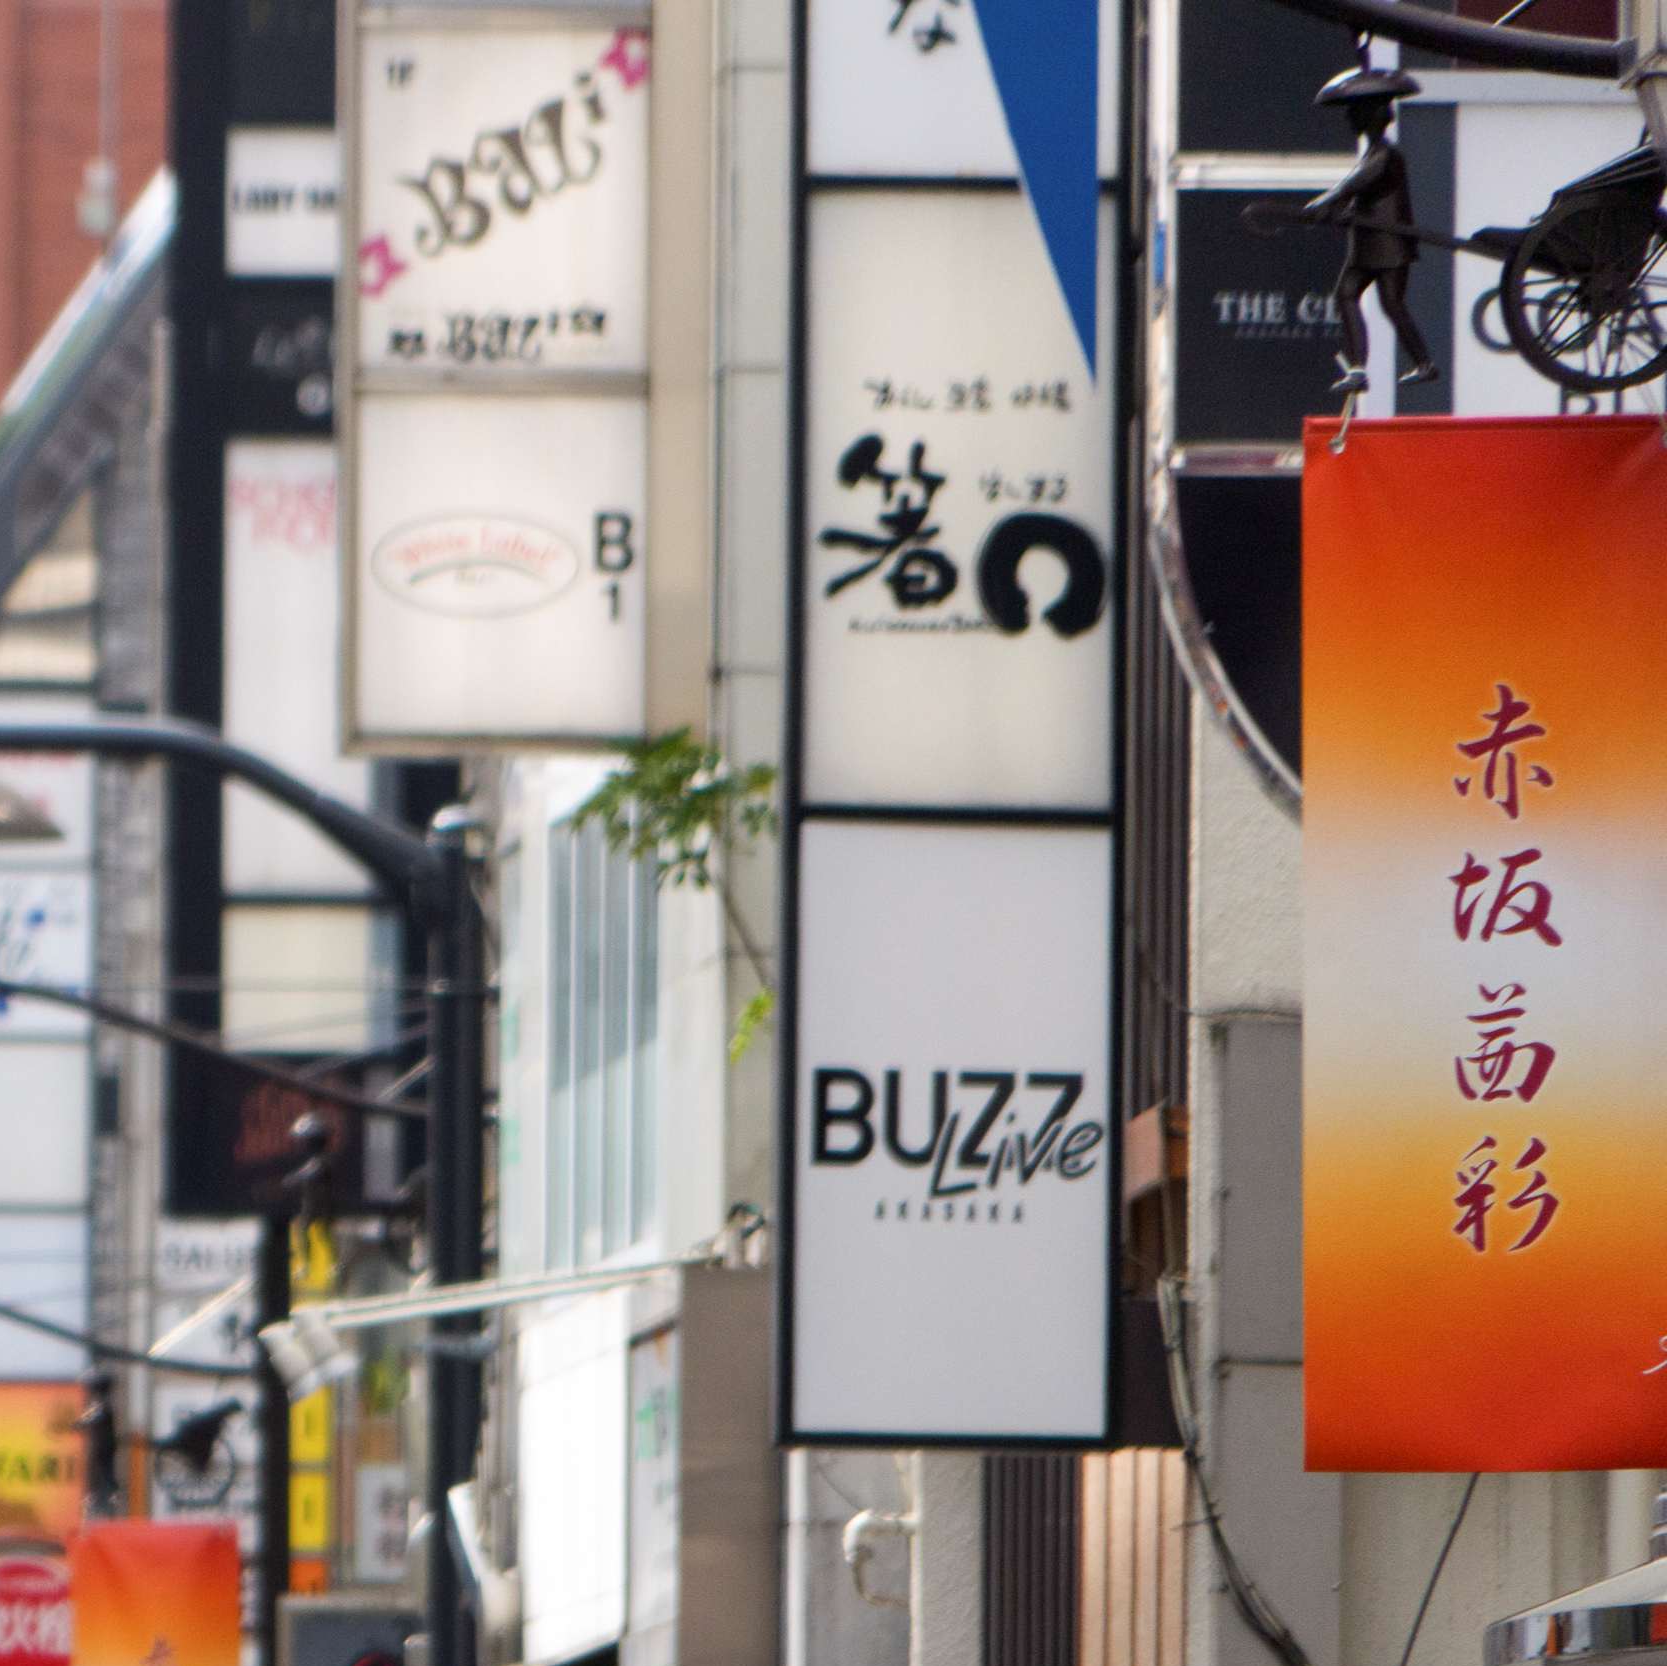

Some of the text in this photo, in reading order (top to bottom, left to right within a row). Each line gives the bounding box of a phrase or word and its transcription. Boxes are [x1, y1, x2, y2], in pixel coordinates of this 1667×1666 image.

[1213, 290, 1288, 325] THE
[1449, 683, 1563, 1254] 赤坂茜彩
[810, 1066, 1083, 1168] BUZZ
[873, 1201, 1026, 1224] AKASAKA
